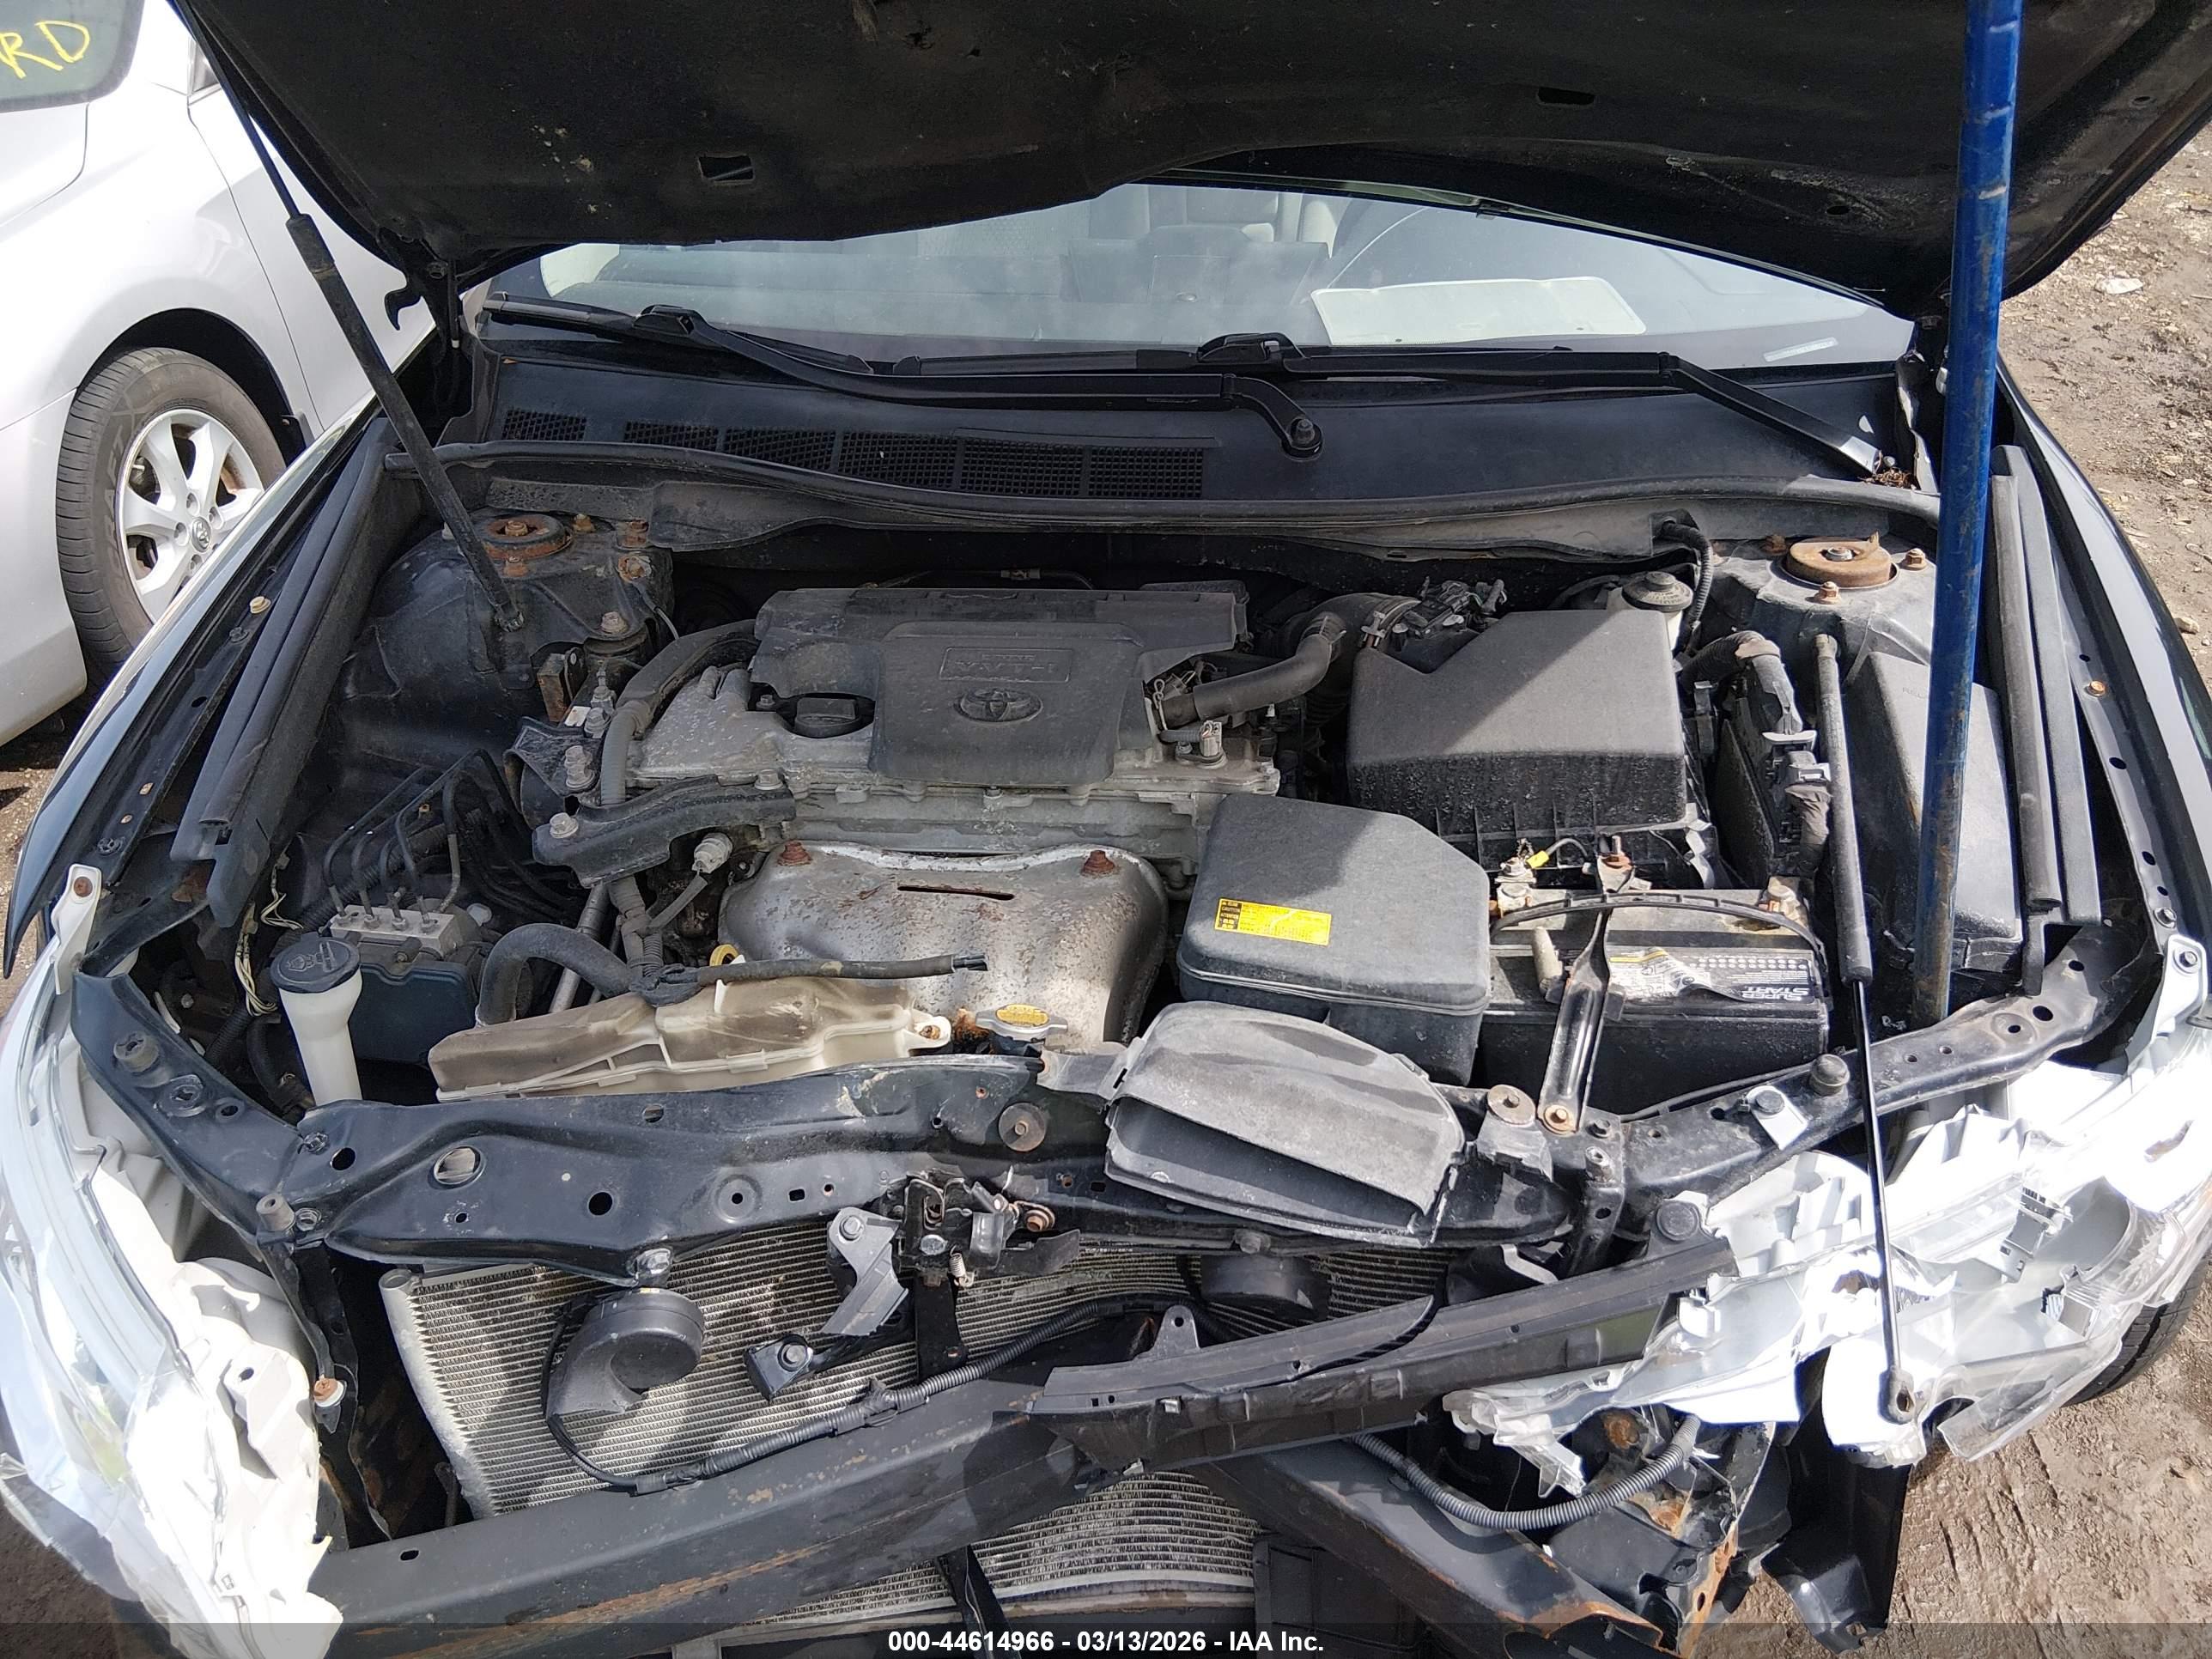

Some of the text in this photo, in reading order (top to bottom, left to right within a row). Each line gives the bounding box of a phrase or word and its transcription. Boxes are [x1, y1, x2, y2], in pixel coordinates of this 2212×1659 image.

[0, 21, 90, 79] RD
[1741, 986, 1809, 996] START
[1742, 992, 1802, 1002] SUPER
